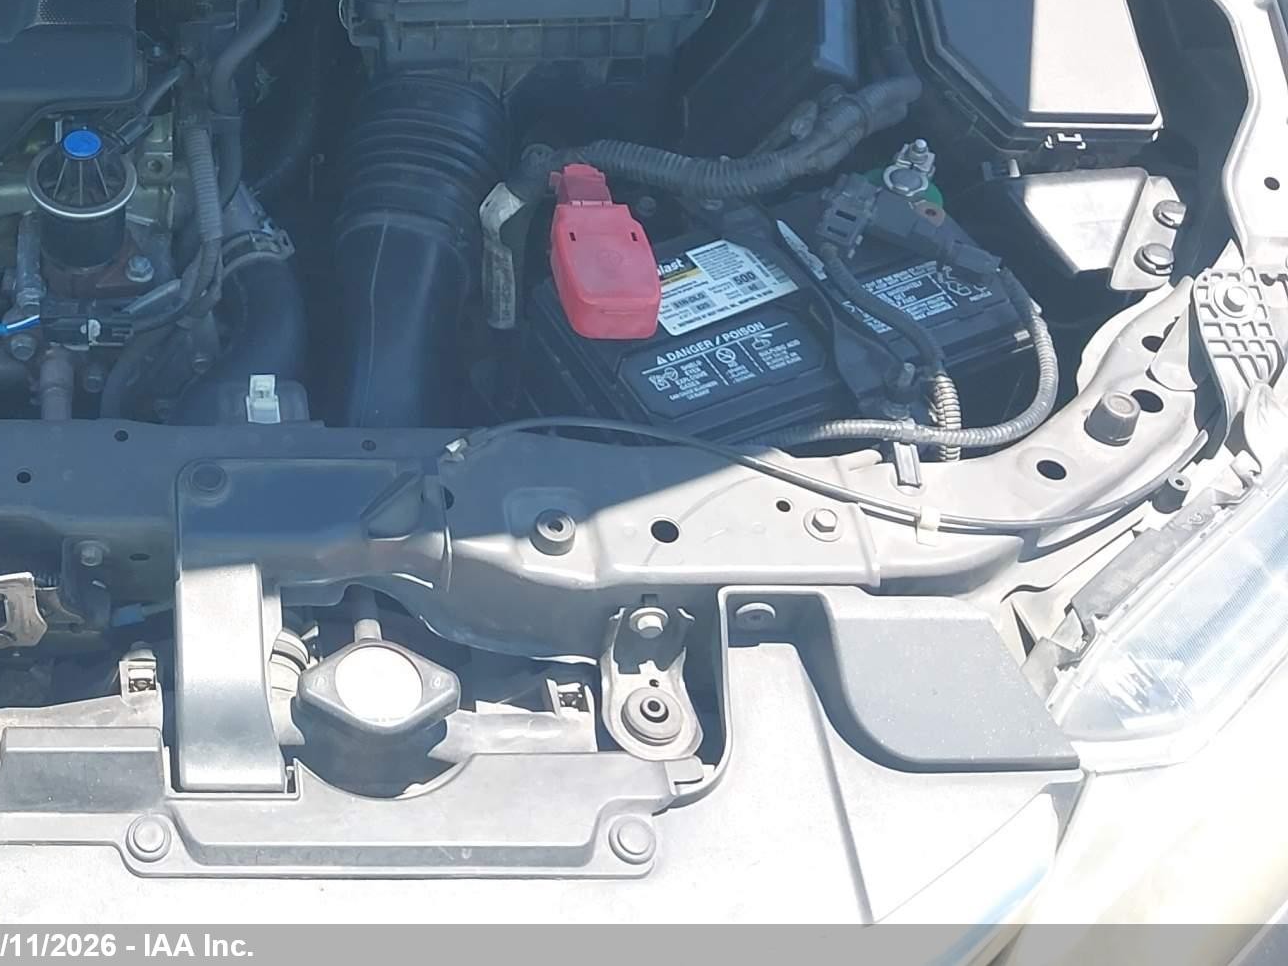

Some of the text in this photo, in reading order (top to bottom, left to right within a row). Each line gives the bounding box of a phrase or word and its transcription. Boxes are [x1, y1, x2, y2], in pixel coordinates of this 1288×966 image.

[657, 258, 685, 277] last
[733, 270, 757, 286] 500
[665, 339, 714, 362] DANGER
[721, 321, 766, 344] POISON
